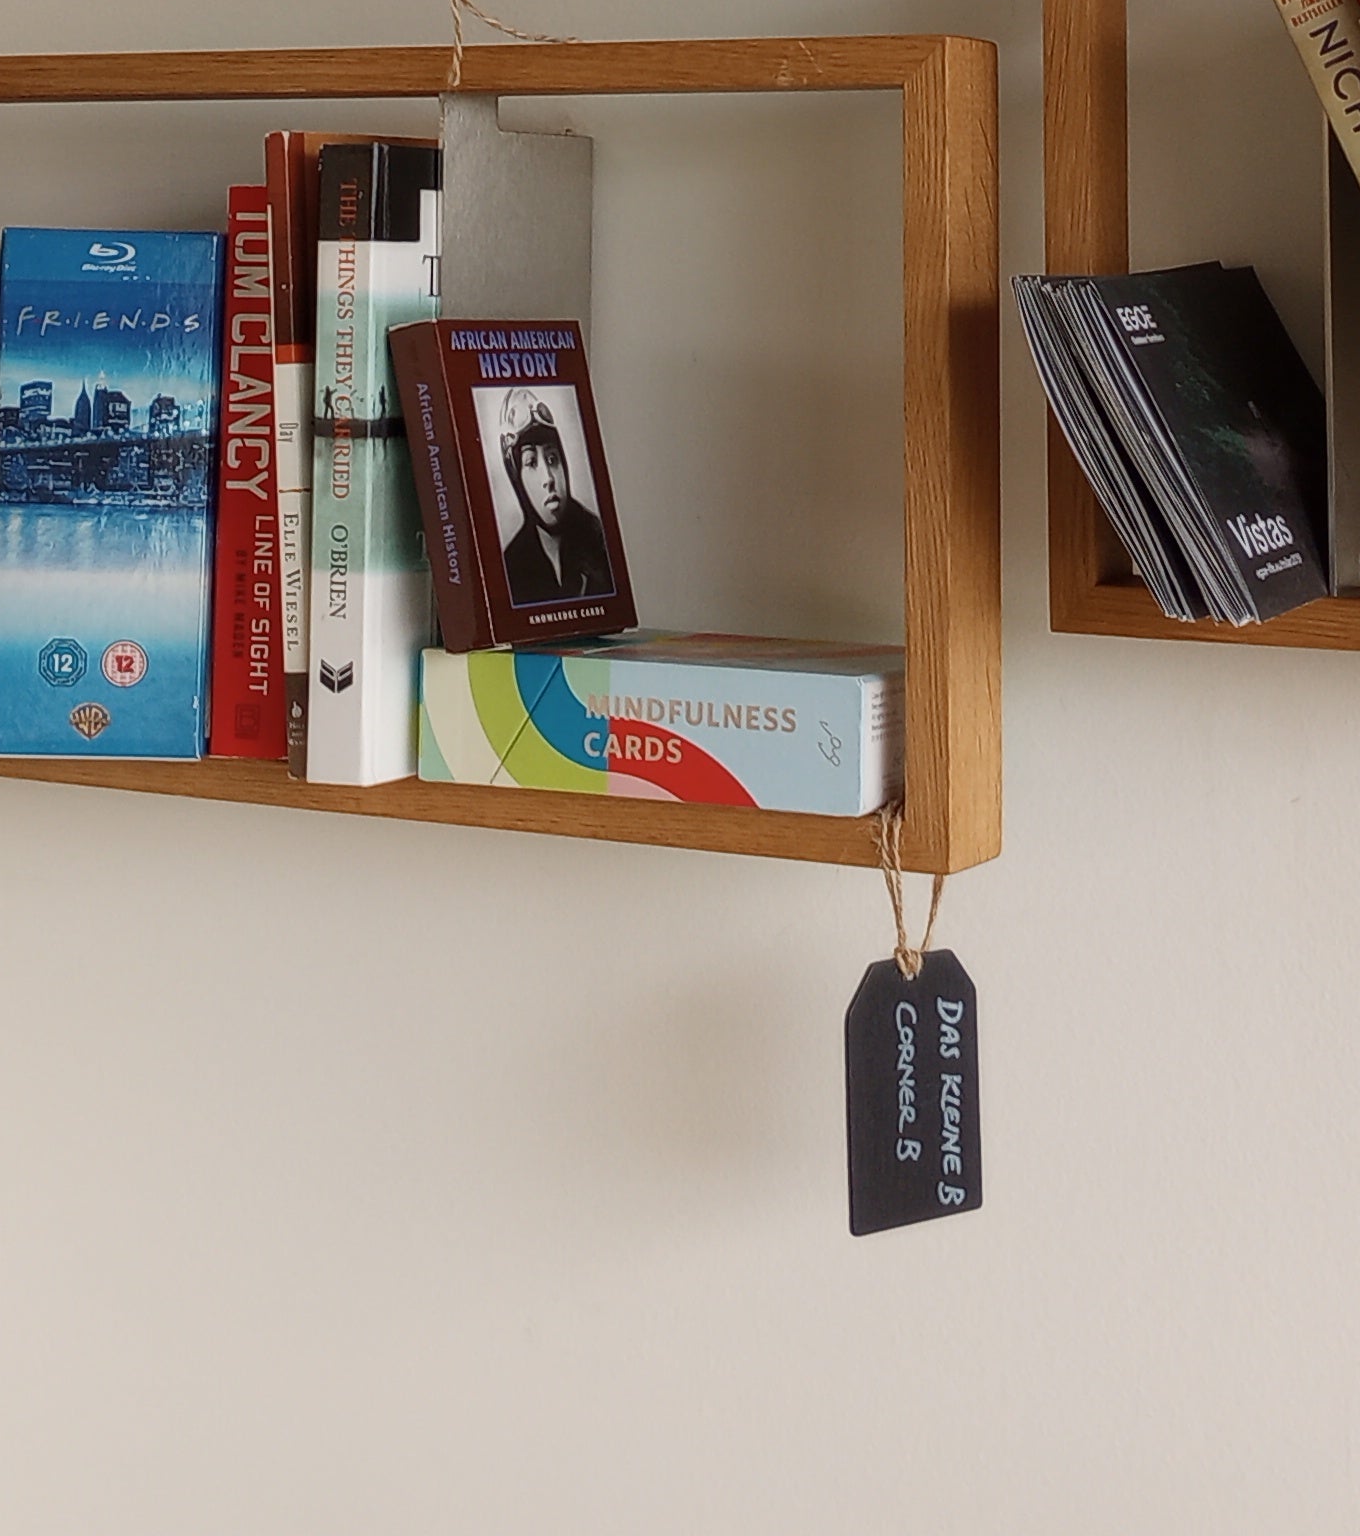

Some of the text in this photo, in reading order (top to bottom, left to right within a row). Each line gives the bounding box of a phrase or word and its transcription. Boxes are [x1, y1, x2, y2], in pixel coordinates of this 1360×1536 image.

[332, 176, 358, 499] THE THINGS THEY CARRIED
[451, 330, 576, 351] AFRICAN AMERICAN
[478, 352, 557, 379] HISTORY
[225, 313, 272, 501] CLANCY
[416, 382, 462, 586] African American History
[1226, 512, 1293, 558] Vistas
[283, 513, 302, 651] ELIE WIESEL
[329, 524, 349, 620] O'BRIEN
[249, 515, 274, 696] LINE OF SIGHT
[529, 606, 605, 625] KNOWLEDGE CARDS
[52, 653, 73, 673] 12
[115, 655, 134, 673] 12
[585, 693, 797, 733] MINDFULNESS
[583, 730, 683, 764] CARDS
[937, 997, 964, 1060] DAS
[896, 1001, 922, 1162] CORNER B
[937, 1180, 966, 1206] B
